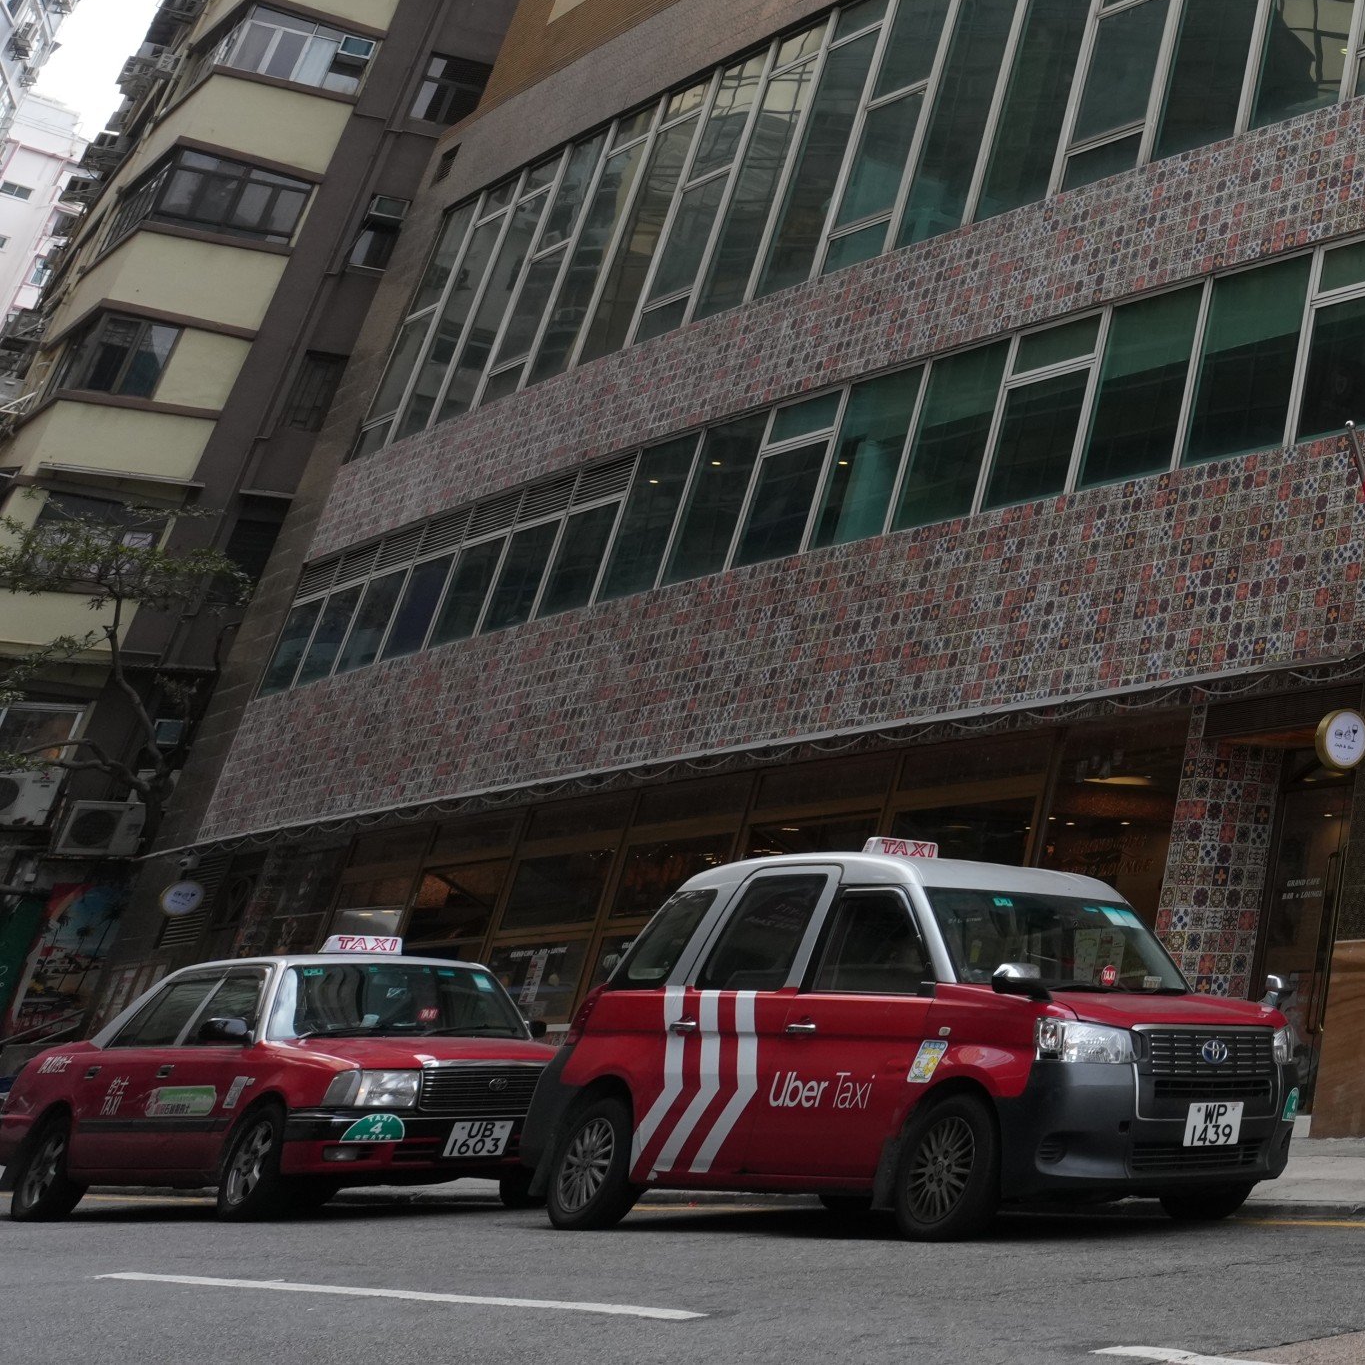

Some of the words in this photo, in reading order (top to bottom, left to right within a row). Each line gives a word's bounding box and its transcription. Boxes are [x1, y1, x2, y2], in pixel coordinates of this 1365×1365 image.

[881, 839, 936, 858] TAXI
[338, 937, 398, 951] TAXI
[1102, 971, 1116, 982] TAXI
[420, 1009, 438, 1020] TAXI
[107, 1076, 129, 1095] 的士
[768, 1071, 830, 1108] Uber
[832, 1072, 876, 1109] Taxi
[100, 1096, 123, 1115] TAXI
[1203, 1104, 1228, 1124] WP
[367, 1114, 394, 1123] TAXI
[369, 1122, 383, 1134] 4
[467, 1122, 496, 1139] UB
[1190, 1124, 1233, 1146] 1439
[449, 1137, 502, 1156] 1603
